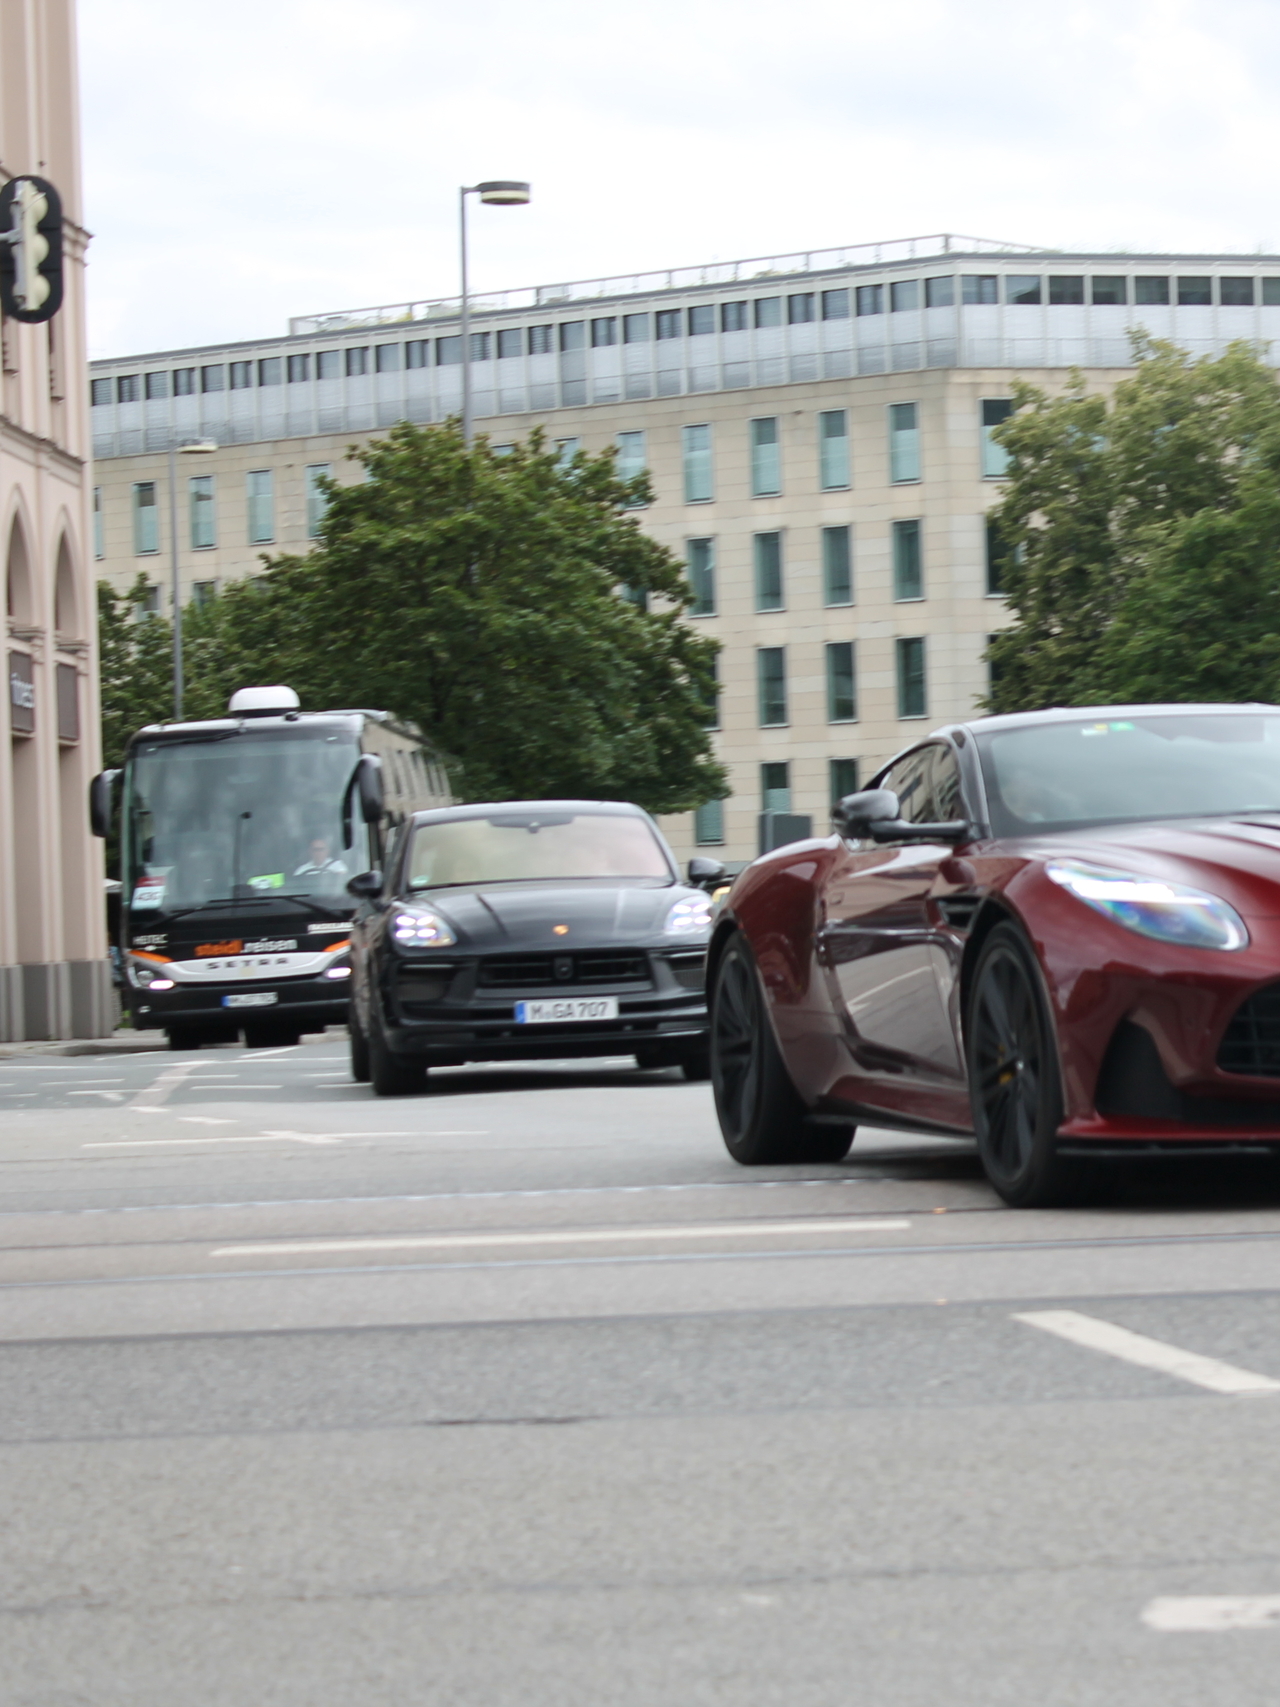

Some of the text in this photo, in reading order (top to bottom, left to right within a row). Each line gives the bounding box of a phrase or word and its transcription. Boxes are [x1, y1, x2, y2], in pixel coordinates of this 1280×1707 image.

[207, 957, 289, 969] SETRA
[530, 1004, 543, 1020] M
[577, 1002, 608, 1018] 707
